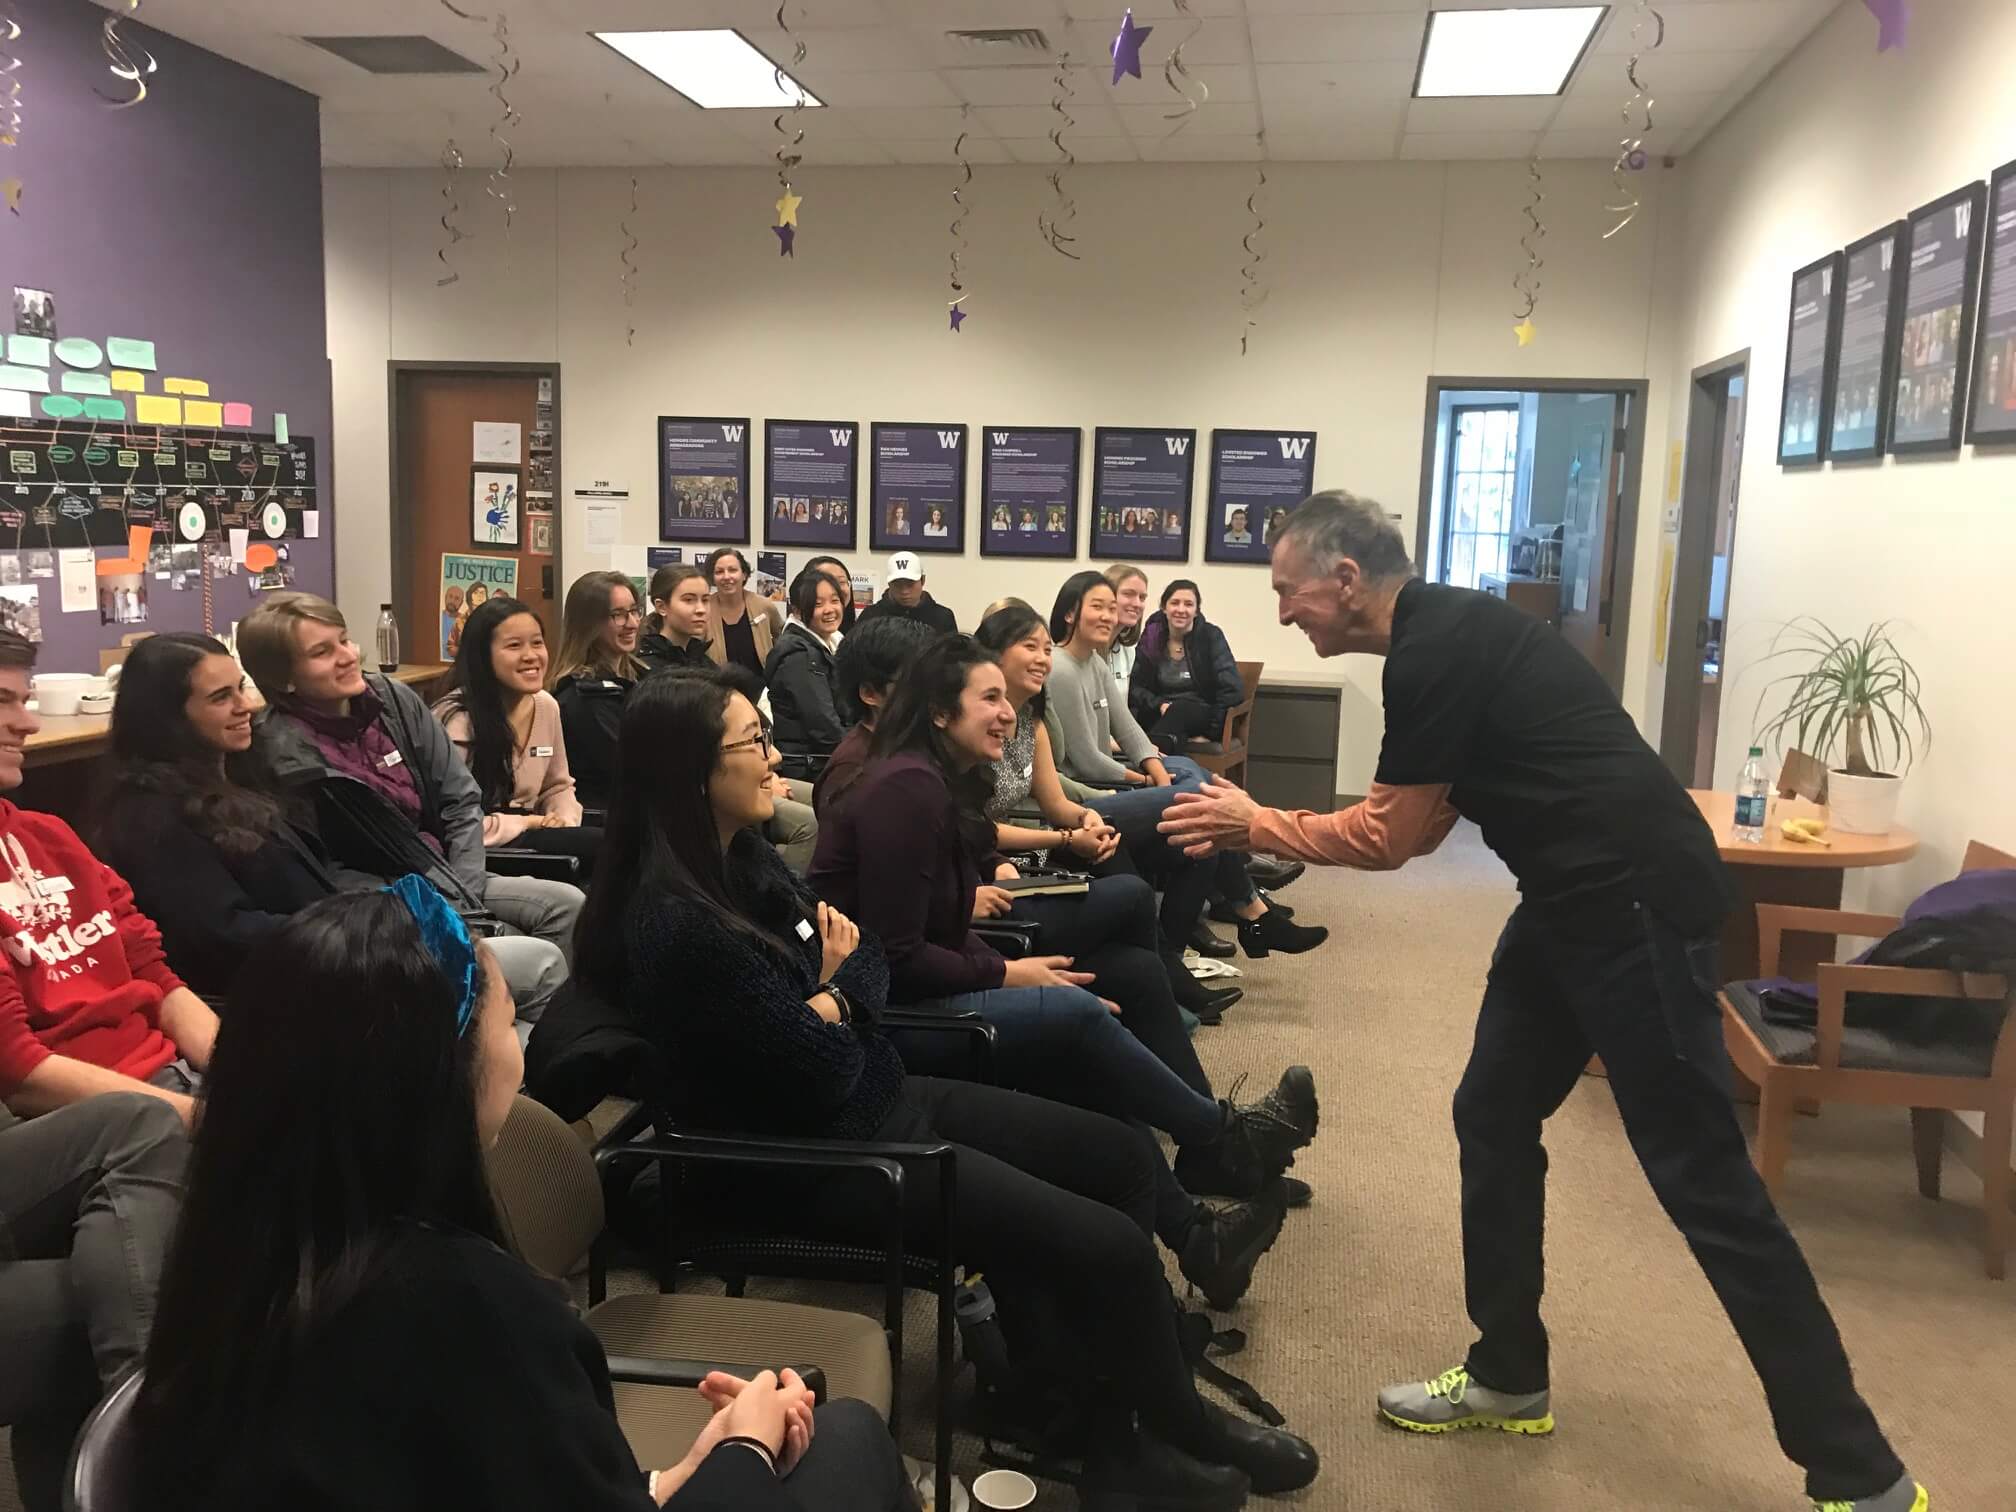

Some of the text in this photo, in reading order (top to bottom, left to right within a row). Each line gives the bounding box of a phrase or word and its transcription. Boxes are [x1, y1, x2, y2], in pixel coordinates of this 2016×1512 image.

[721, 425, 744, 442] W
[829, 428, 852, 446] W
[937, 431, 960, 448] W
[992, 432, 1010, 445] W
[1165, 437, 1189, 455] W
[1278, 437, 1311, 459] W
[696, 555, 708, 563] W
[896, 559, 909, 570] W
[445, 562, 514, 584] JUSTICE
